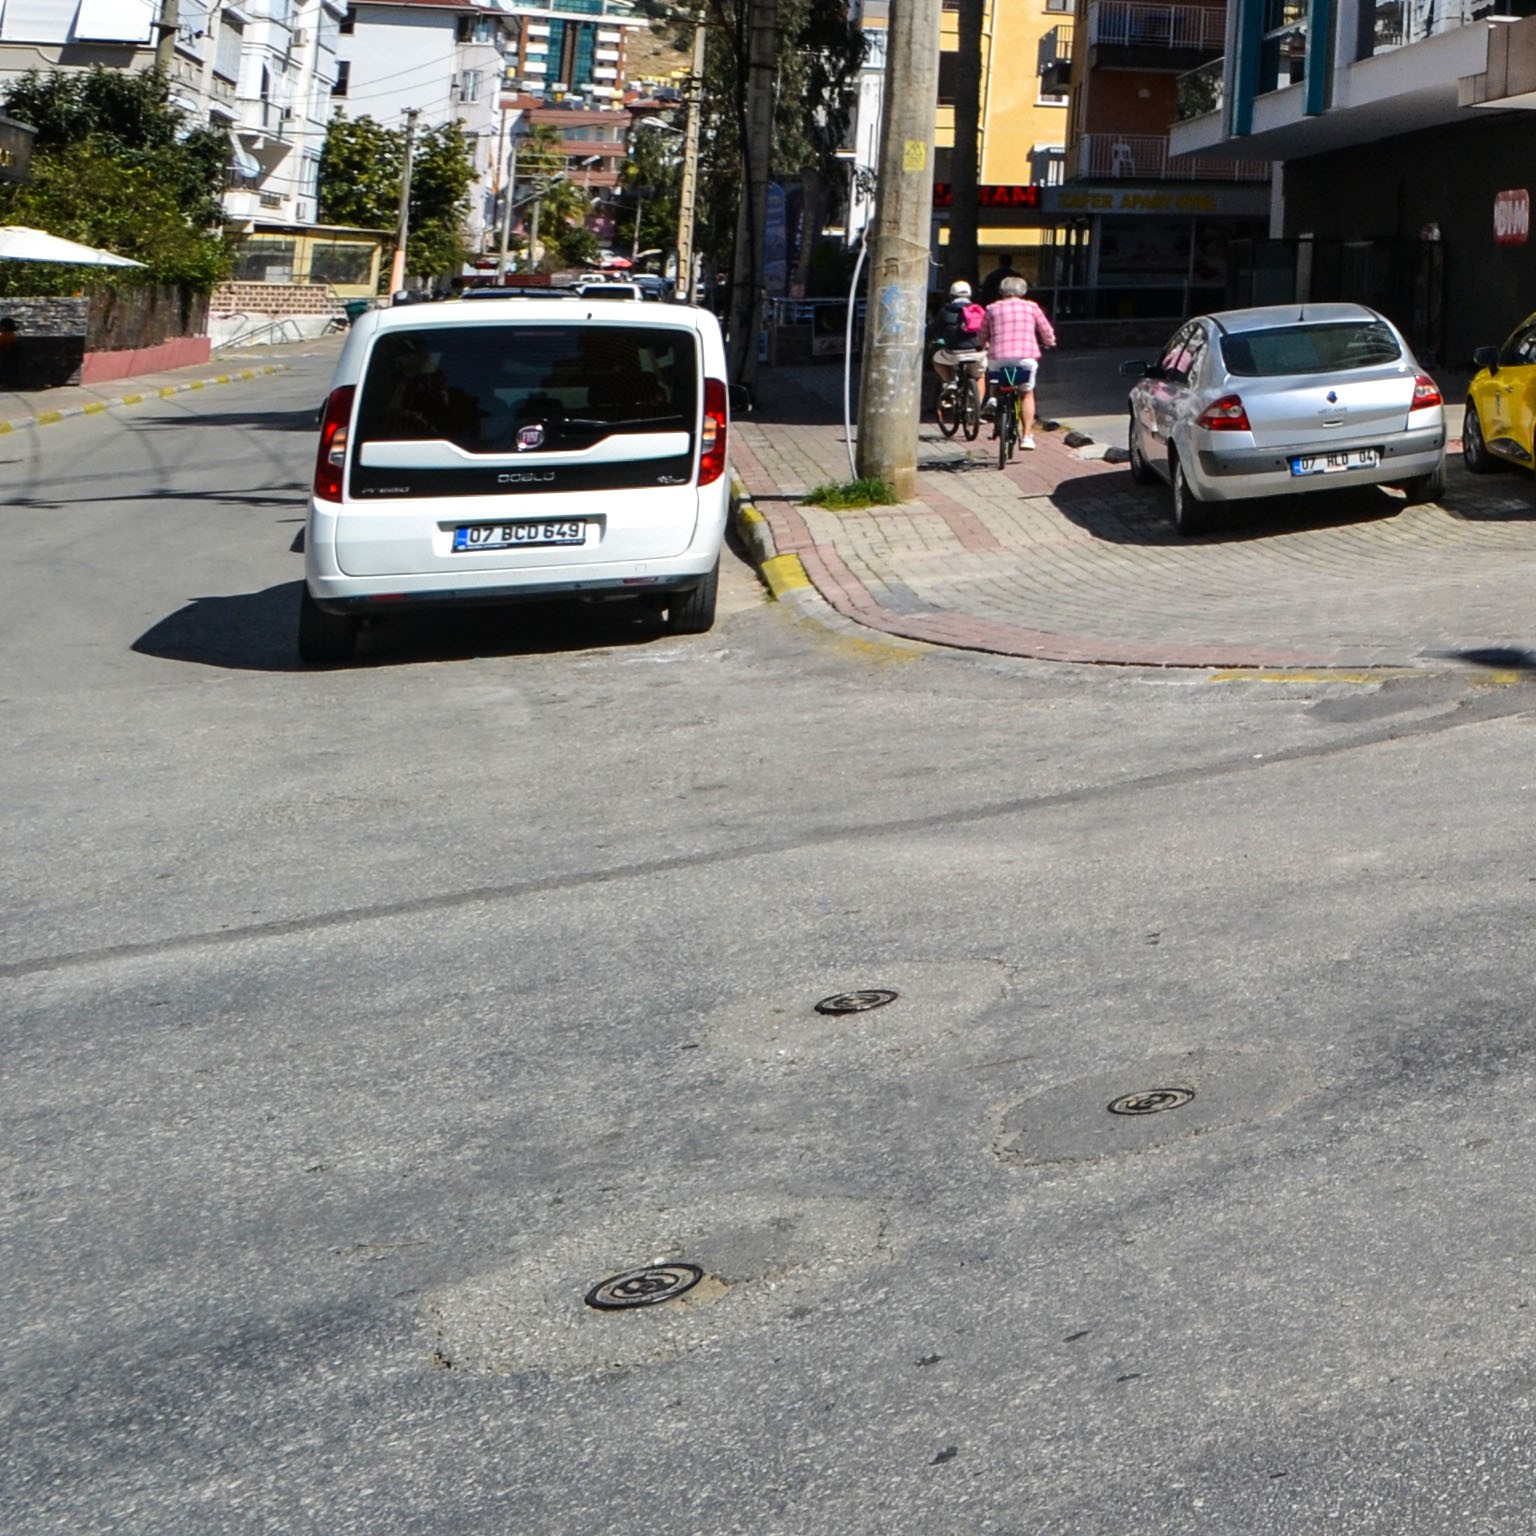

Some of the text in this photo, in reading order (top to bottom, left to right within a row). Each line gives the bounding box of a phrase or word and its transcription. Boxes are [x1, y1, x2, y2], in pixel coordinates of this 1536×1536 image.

[1302, 457, 1316, 470] 07
[469, 522, 580, 544] 07 BCD 649
